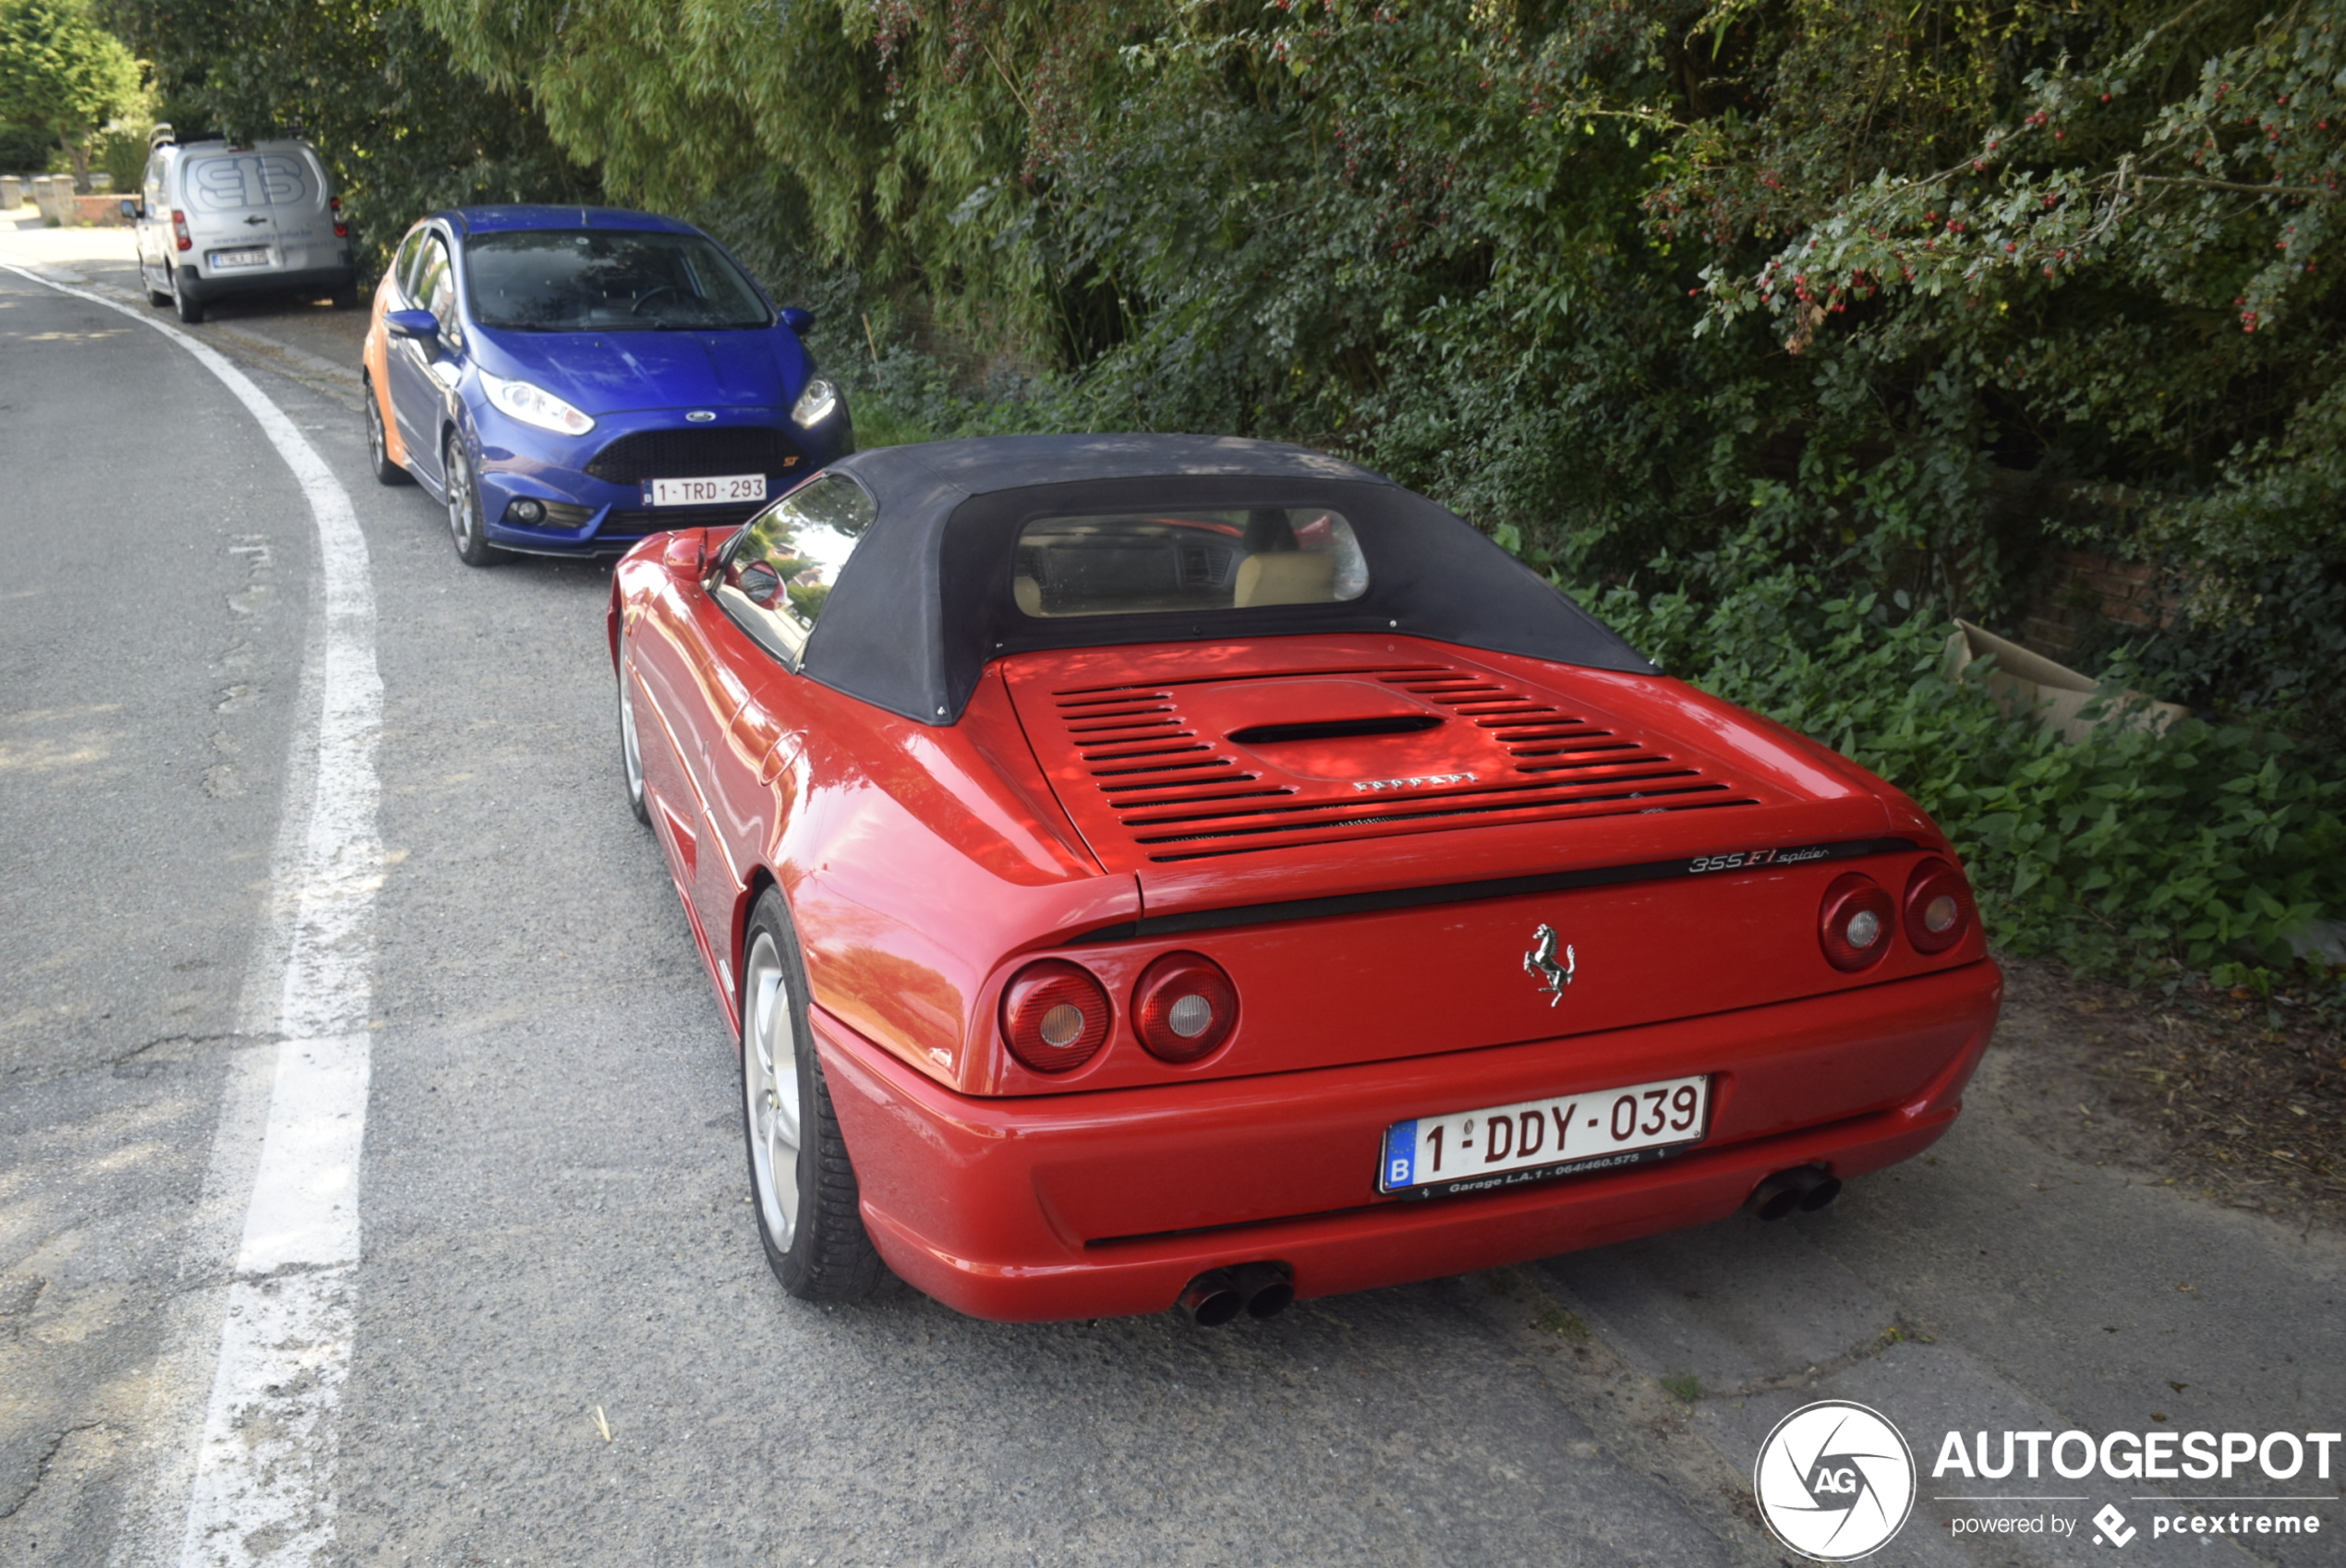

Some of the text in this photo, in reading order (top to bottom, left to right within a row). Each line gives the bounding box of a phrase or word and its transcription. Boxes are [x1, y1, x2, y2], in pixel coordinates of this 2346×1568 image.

[1688, 853, 1746, 873] 355
[1776, 846, 1830, 864] spider
[1391, 1159, 1409, 1182] B
[1449, 1177, 1502, 1193] Garage
[1506, 1169, 1542, 1184] L.A.1
[1555, 1153, 1639, 1176] 064/460.575
